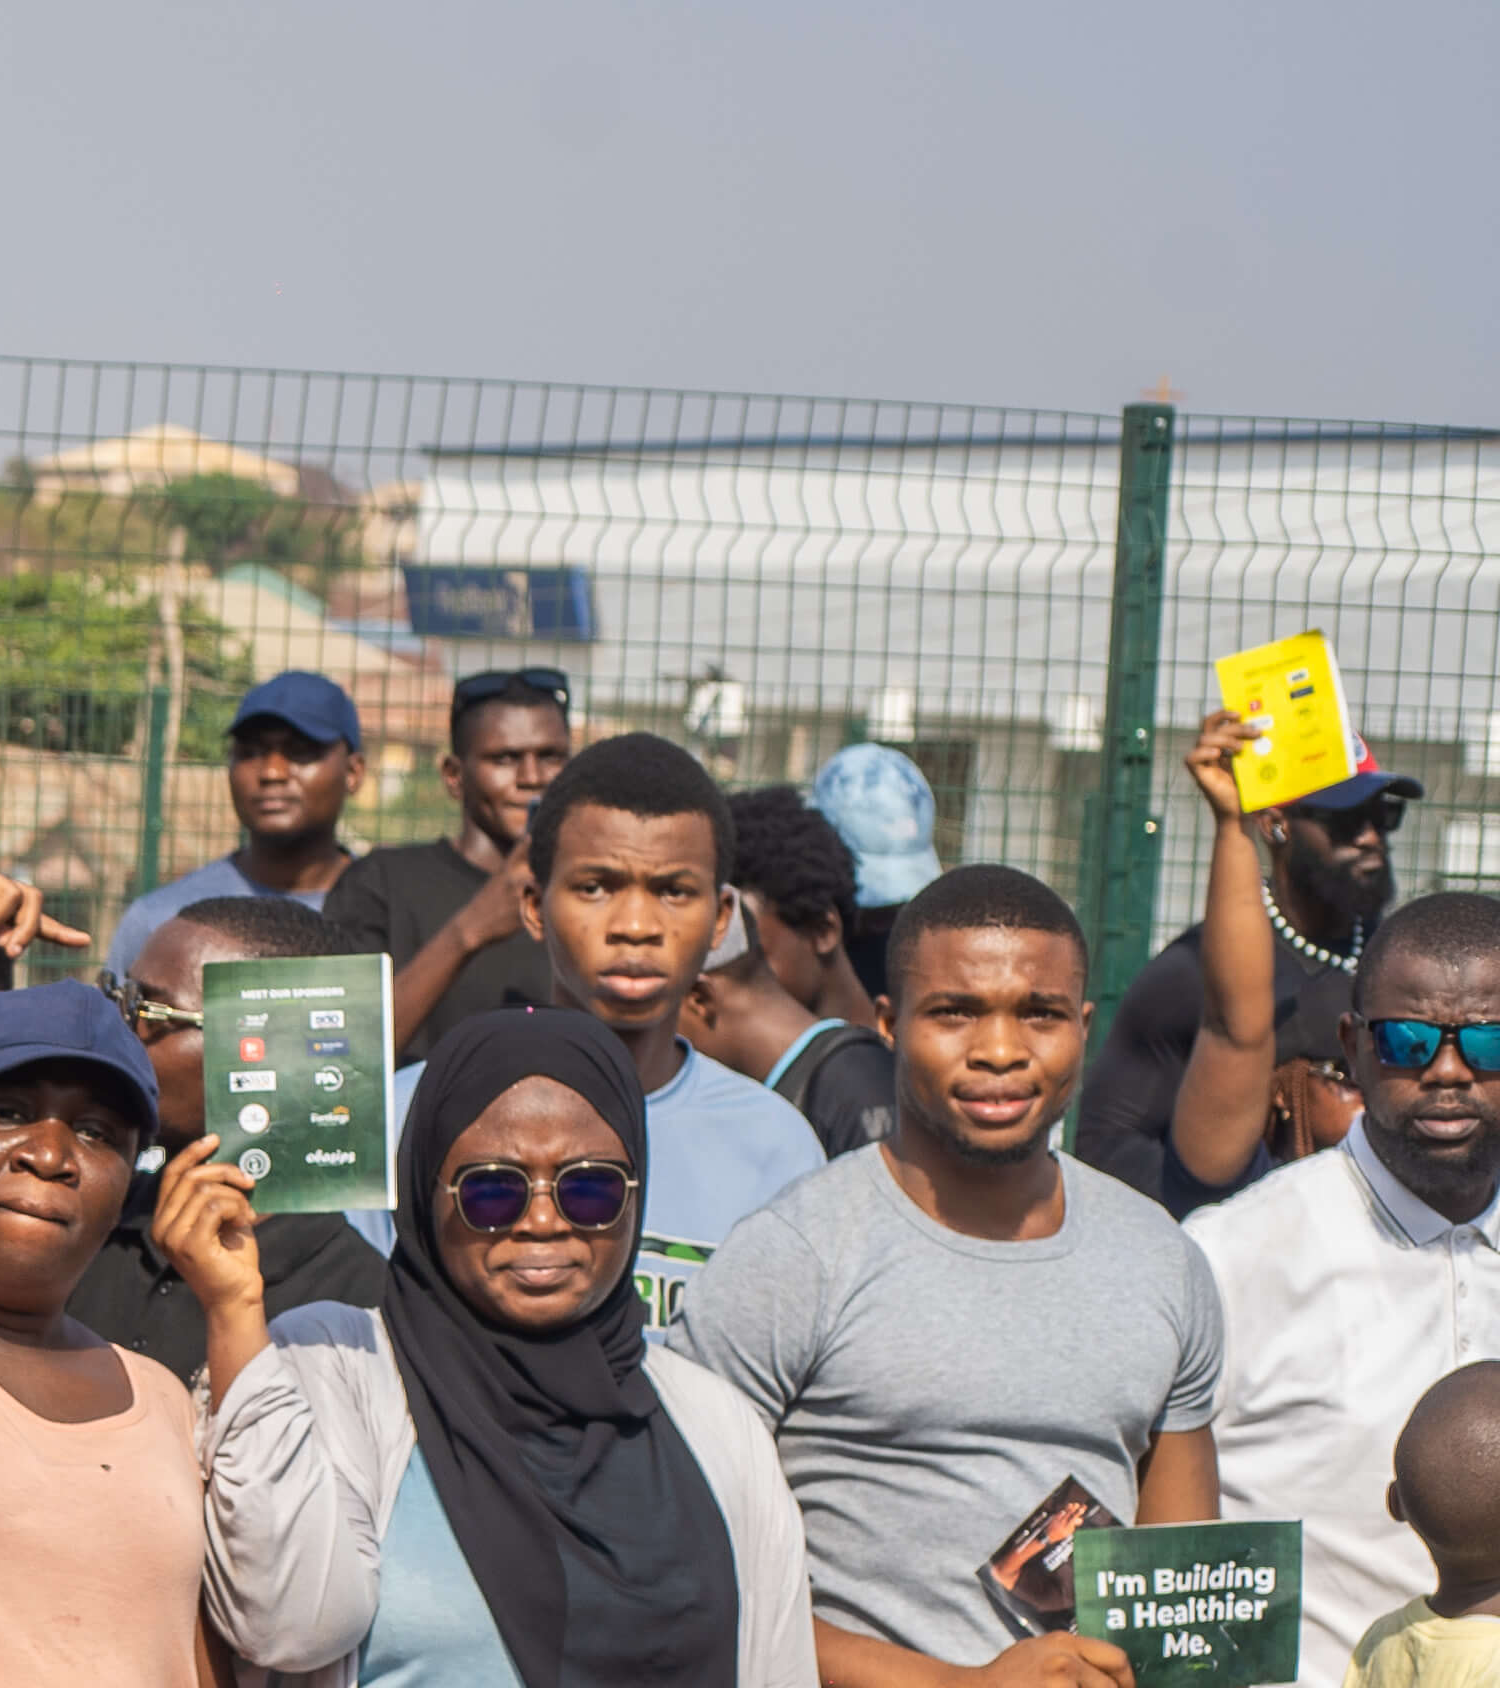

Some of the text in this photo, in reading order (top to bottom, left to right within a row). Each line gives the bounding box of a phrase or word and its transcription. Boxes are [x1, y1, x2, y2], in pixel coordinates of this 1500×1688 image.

[1097, 1560, 1276, 1598] I'm Building
[1106, 1593, 1269, 1630] a Healthier
[1161, 1630, 1212, 1658] Me.
